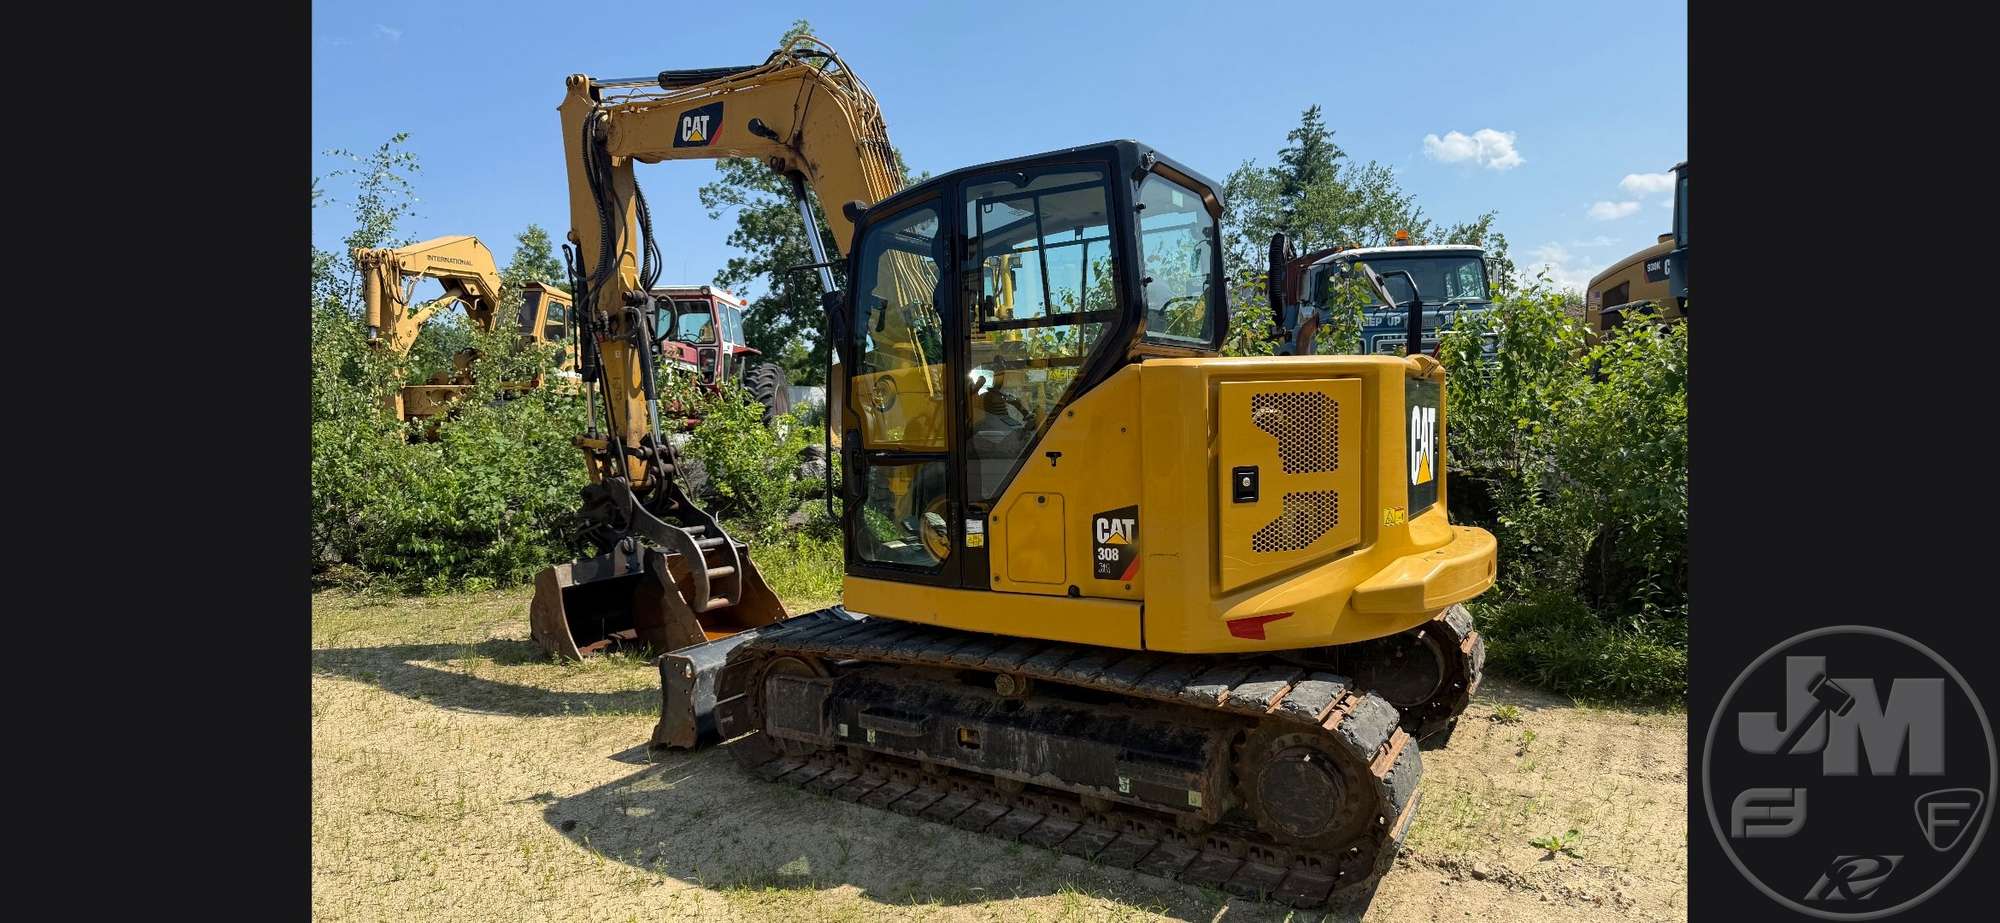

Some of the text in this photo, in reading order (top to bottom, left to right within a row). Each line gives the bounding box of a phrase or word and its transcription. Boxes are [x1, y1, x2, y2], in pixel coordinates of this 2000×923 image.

[682, 115, 710, 142] CAT
[427, 254, 473, 266] INTERNATIONAL
[1388, 314, 1401, 326] UP
[1411, 405, 1436, 485] CAT
[1096, 517, 1135, 545] CAT
[1097, 547, 1120, 561] 308
